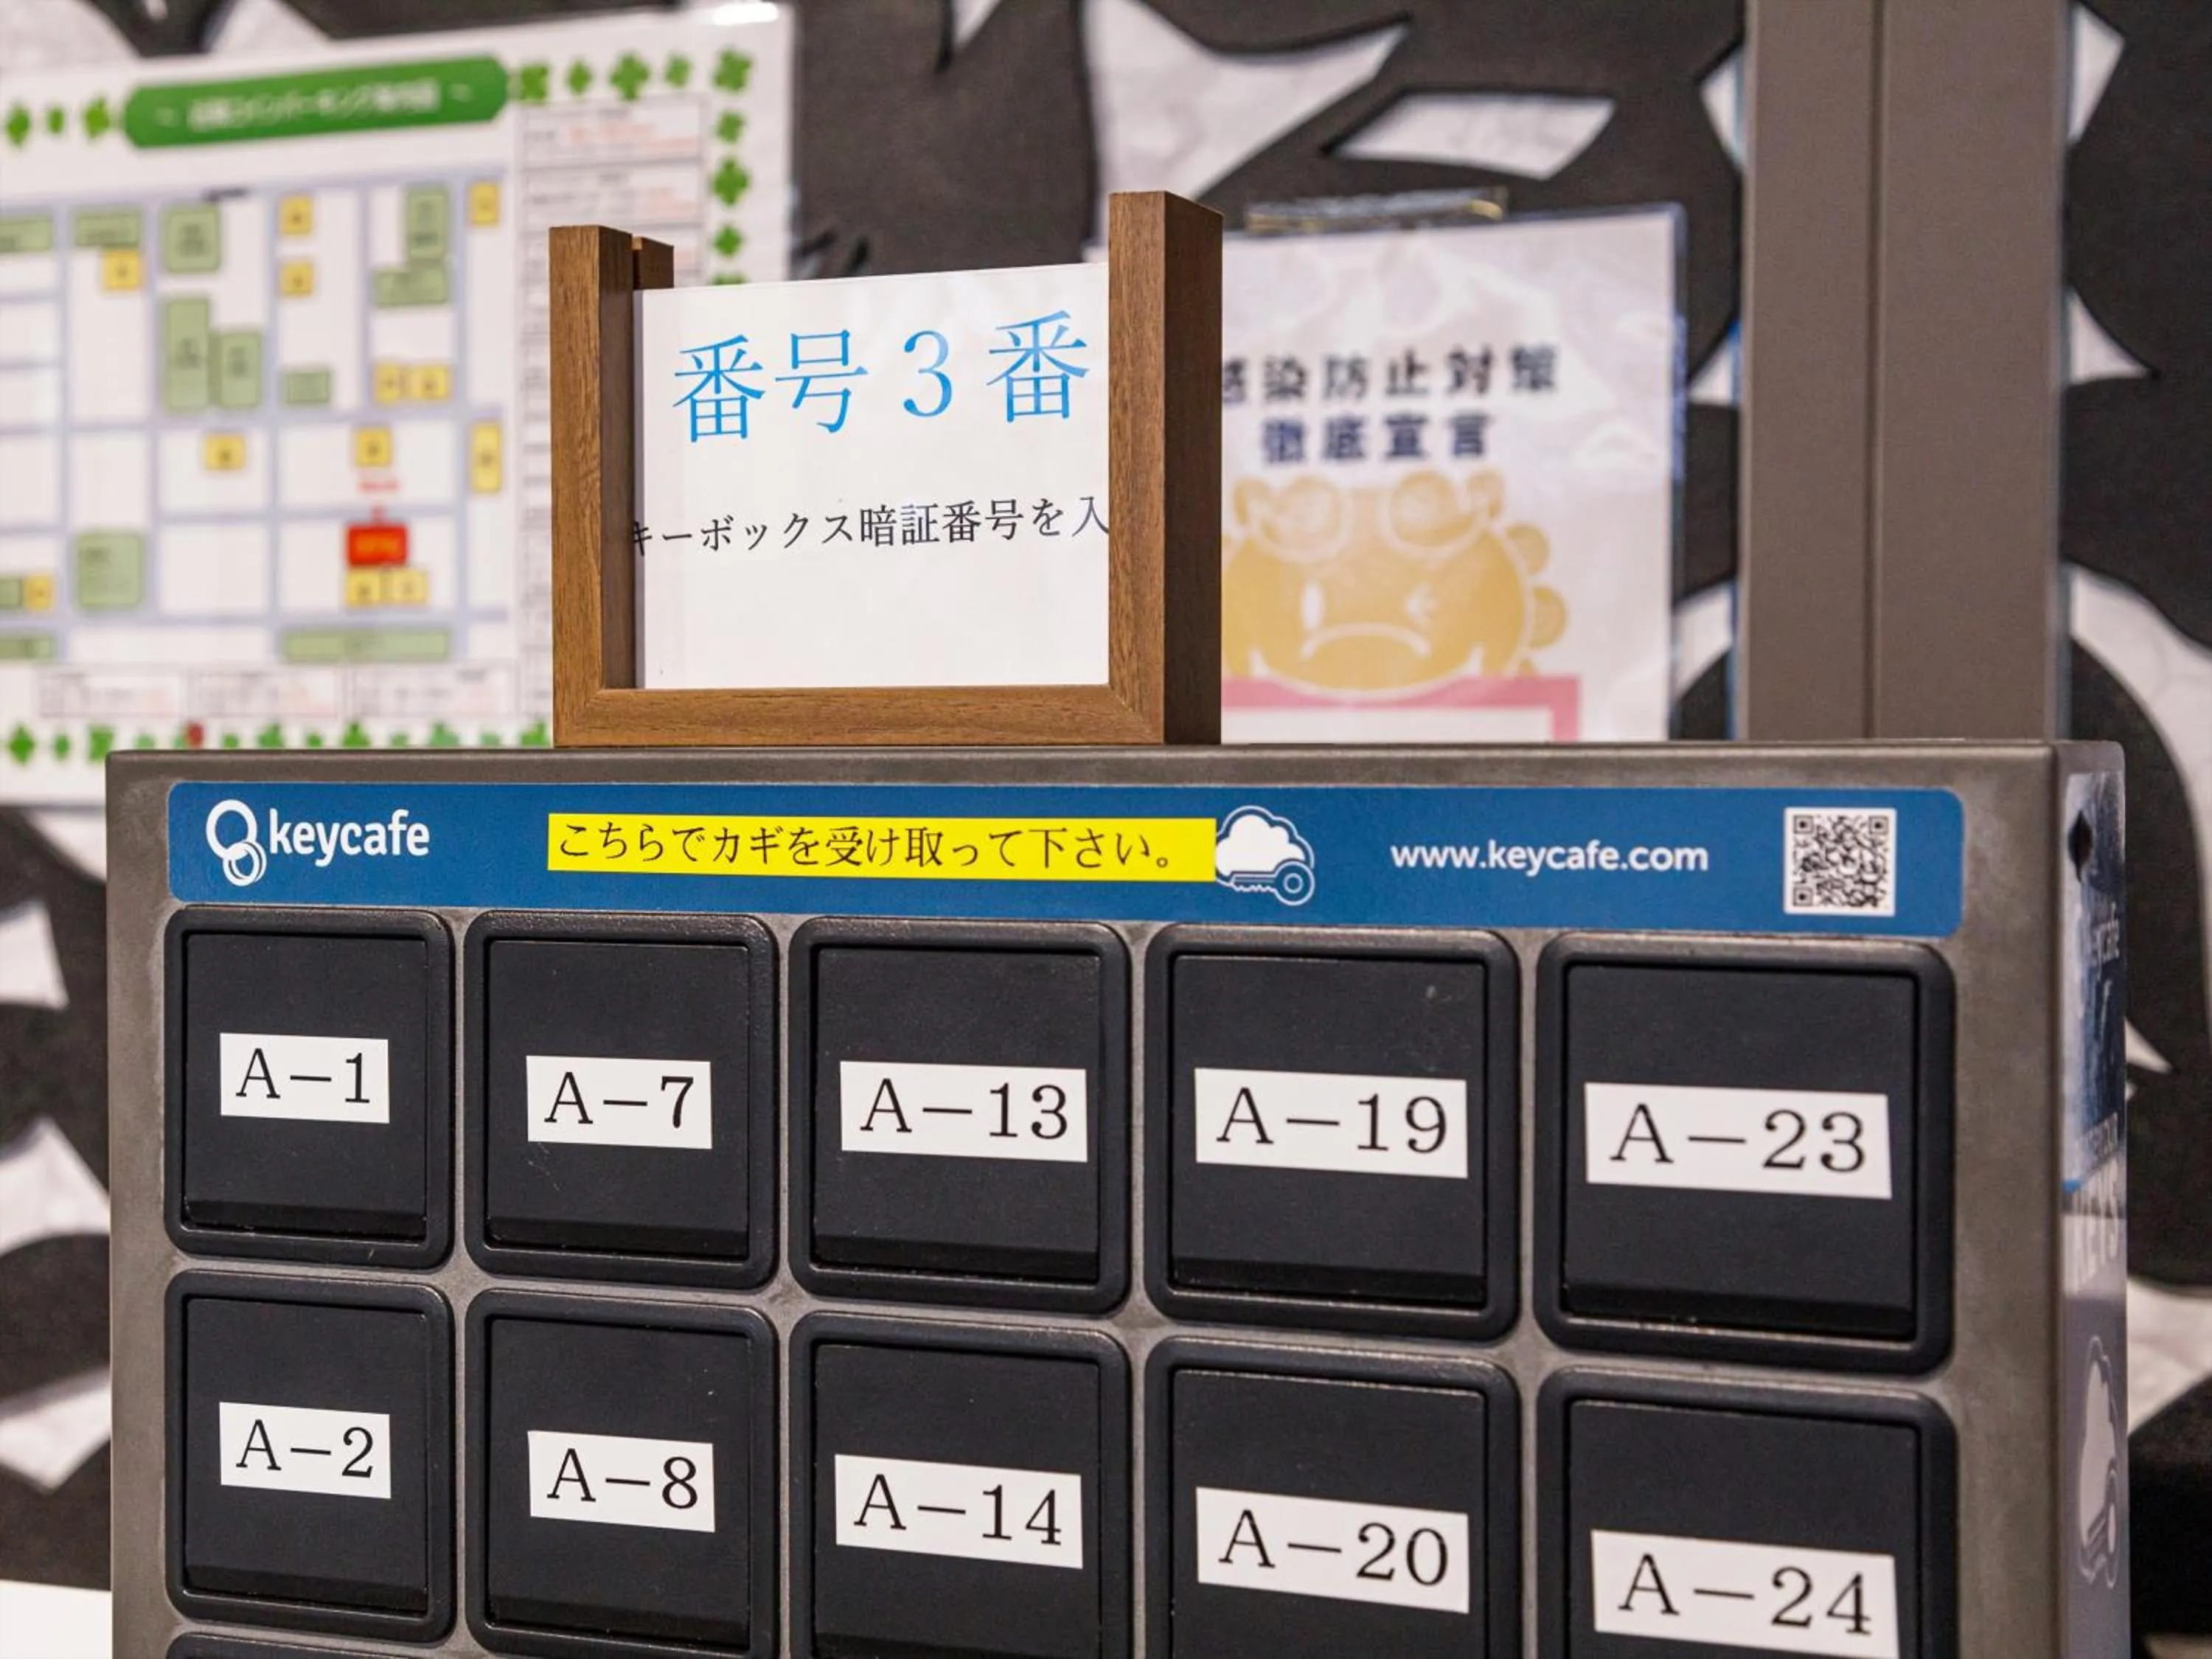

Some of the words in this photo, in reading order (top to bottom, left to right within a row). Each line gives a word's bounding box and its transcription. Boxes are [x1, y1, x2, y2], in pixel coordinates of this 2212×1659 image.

[672, 310, 1090, 444] 番号3番
[633, 495, 1109, 556] キーボックス暗証番号を入
[268, 808, 430, 867] keycafe
[560, 821, 1169, 869] こちらでカギを受け取って下さい。
[1390, 838, 1709, 877] www.keycafe.com
